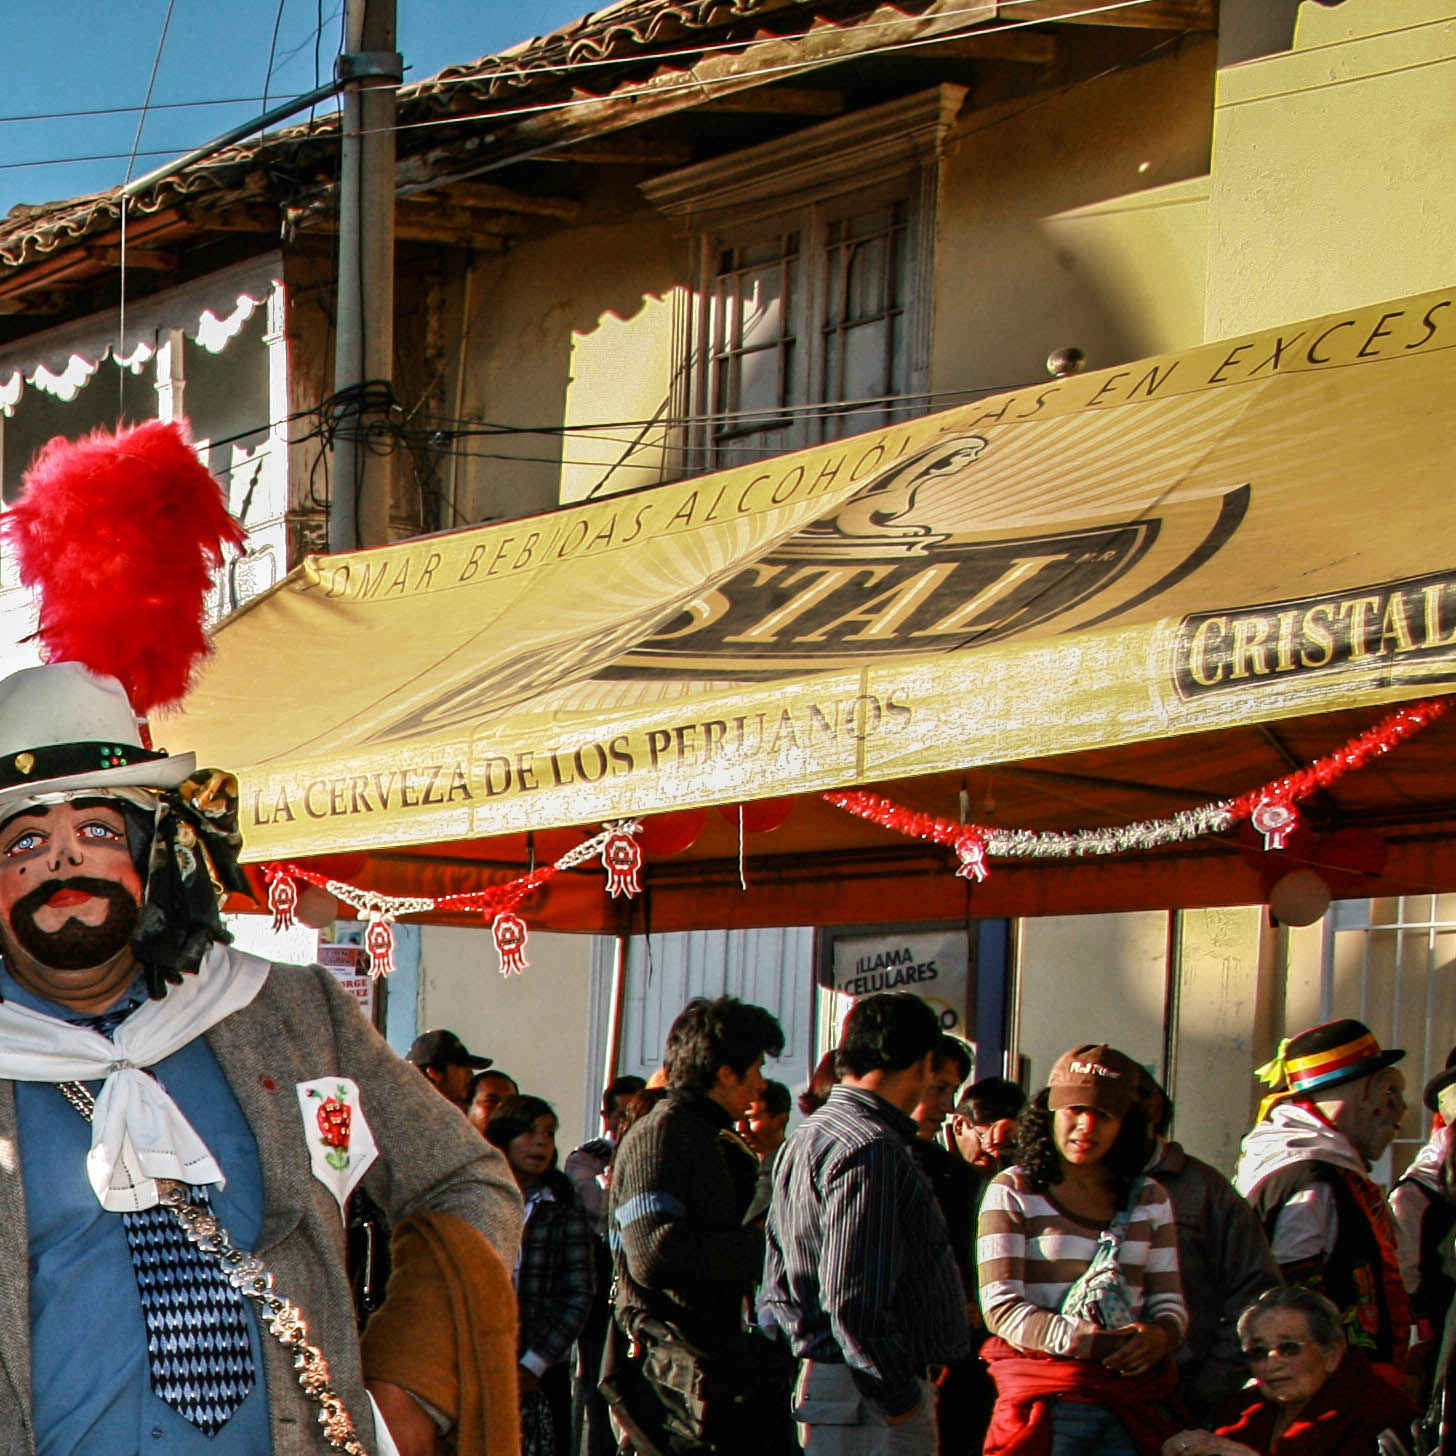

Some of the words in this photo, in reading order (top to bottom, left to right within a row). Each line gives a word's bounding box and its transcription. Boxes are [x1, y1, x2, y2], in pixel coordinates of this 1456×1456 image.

[301, 552, 443, 599] TOMAR
[458, 503, 653, 583] BEBIDAS
[1086, 361, 1180, 407] EN
[1207, 300, 1453, 385] EXCES
[648, 552, 1072, 645] STAL
[1190, 583, 1456, 687] CRISTAL
[252, 784, 296, 827] LA
[303, 762, 473, 818] CERVEZA
[484, 750, 540, 798] DE
[547, 735, 635, 788] LOS
[644, 686, 913, 770] PERUANOS
